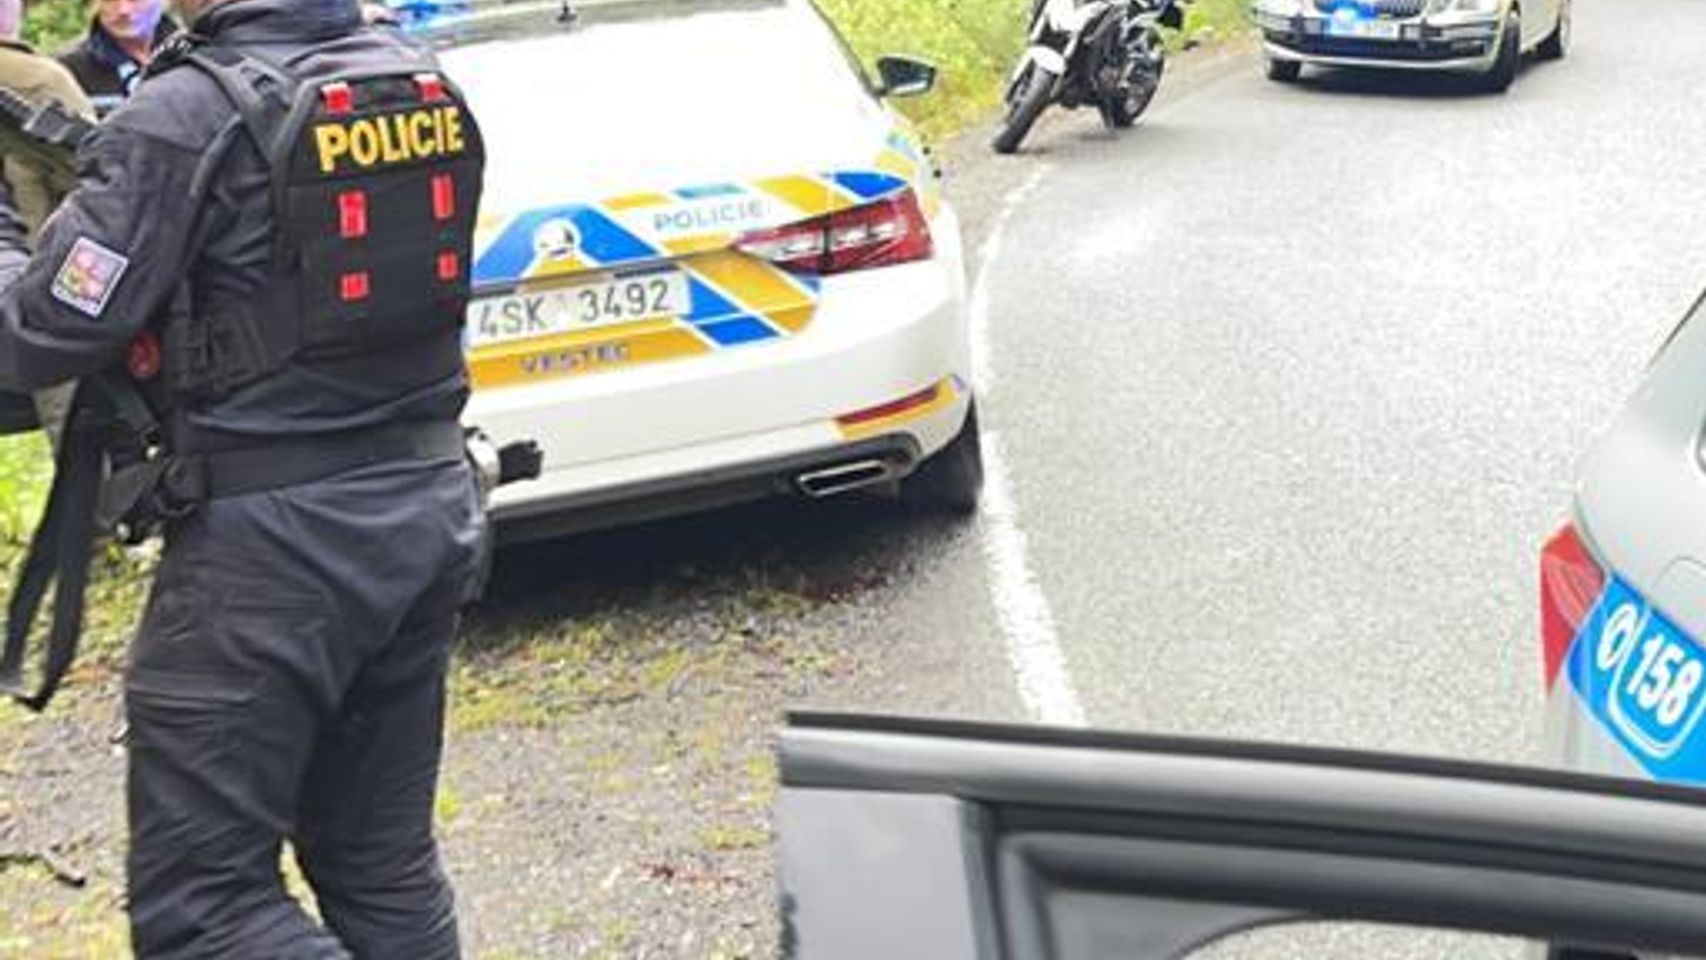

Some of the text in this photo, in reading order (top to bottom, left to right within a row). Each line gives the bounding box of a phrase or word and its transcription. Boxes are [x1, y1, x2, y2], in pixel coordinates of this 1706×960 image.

[315, 106, 464, 173] POLICIE
[653, 198, 764, 231] POLICIE
[479, 279, 671, 336] 4SK 3492
[1626, 633, 1704, 726] 158
